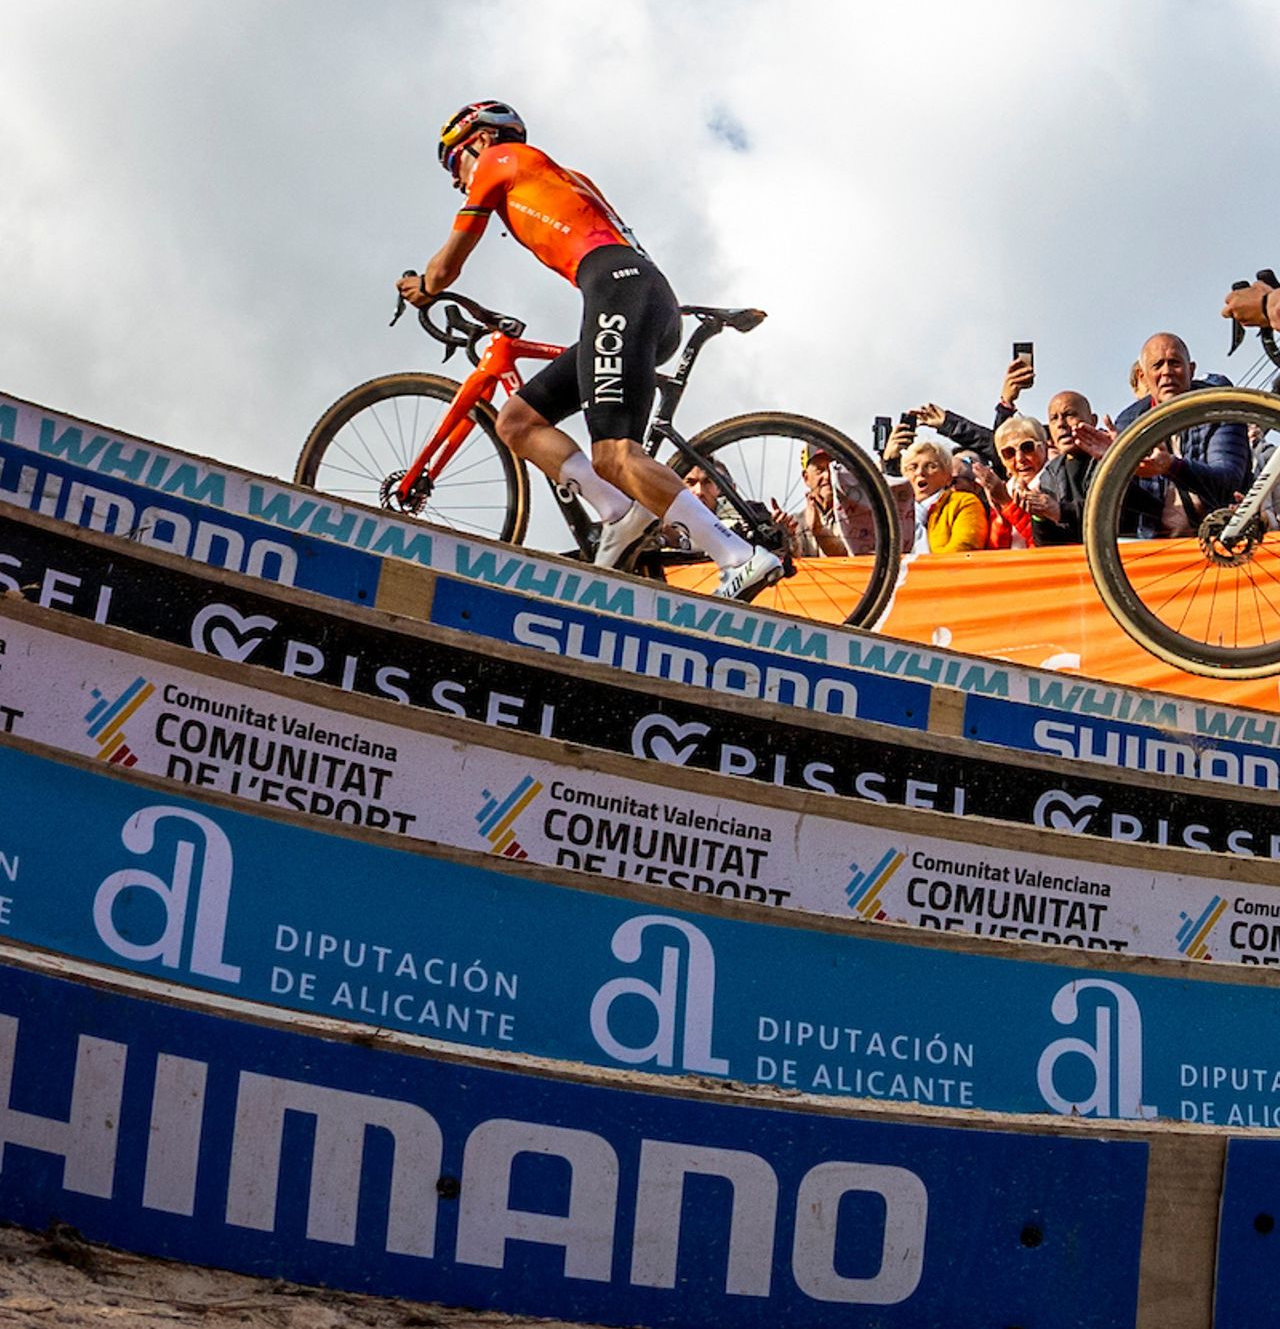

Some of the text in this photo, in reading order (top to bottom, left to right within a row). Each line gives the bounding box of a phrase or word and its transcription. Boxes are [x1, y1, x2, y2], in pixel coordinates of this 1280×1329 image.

[594, 312, 627, 405] INEOS
[155, 712, 393, 801] COMUNITAT
[163, 684, 398, 764] Comunitat Valenciana
[544, 808, 768, 880] COMUNITAT
[551, 781, 773, 843] Comunitat Valenciana
[907, 878, 1108, 932] COMUNITAT
[911, 851, 1112, 898] Comunitat Valenciana
[274, 924, 518, 1001] DIPUTACIÓN
[272, 966, 516, 1042] DE ALICANTE
[758, 1017, 974, 1068] DIPUTACIÓN
[757, 1056, 974, 1106] DE ALICANTE
